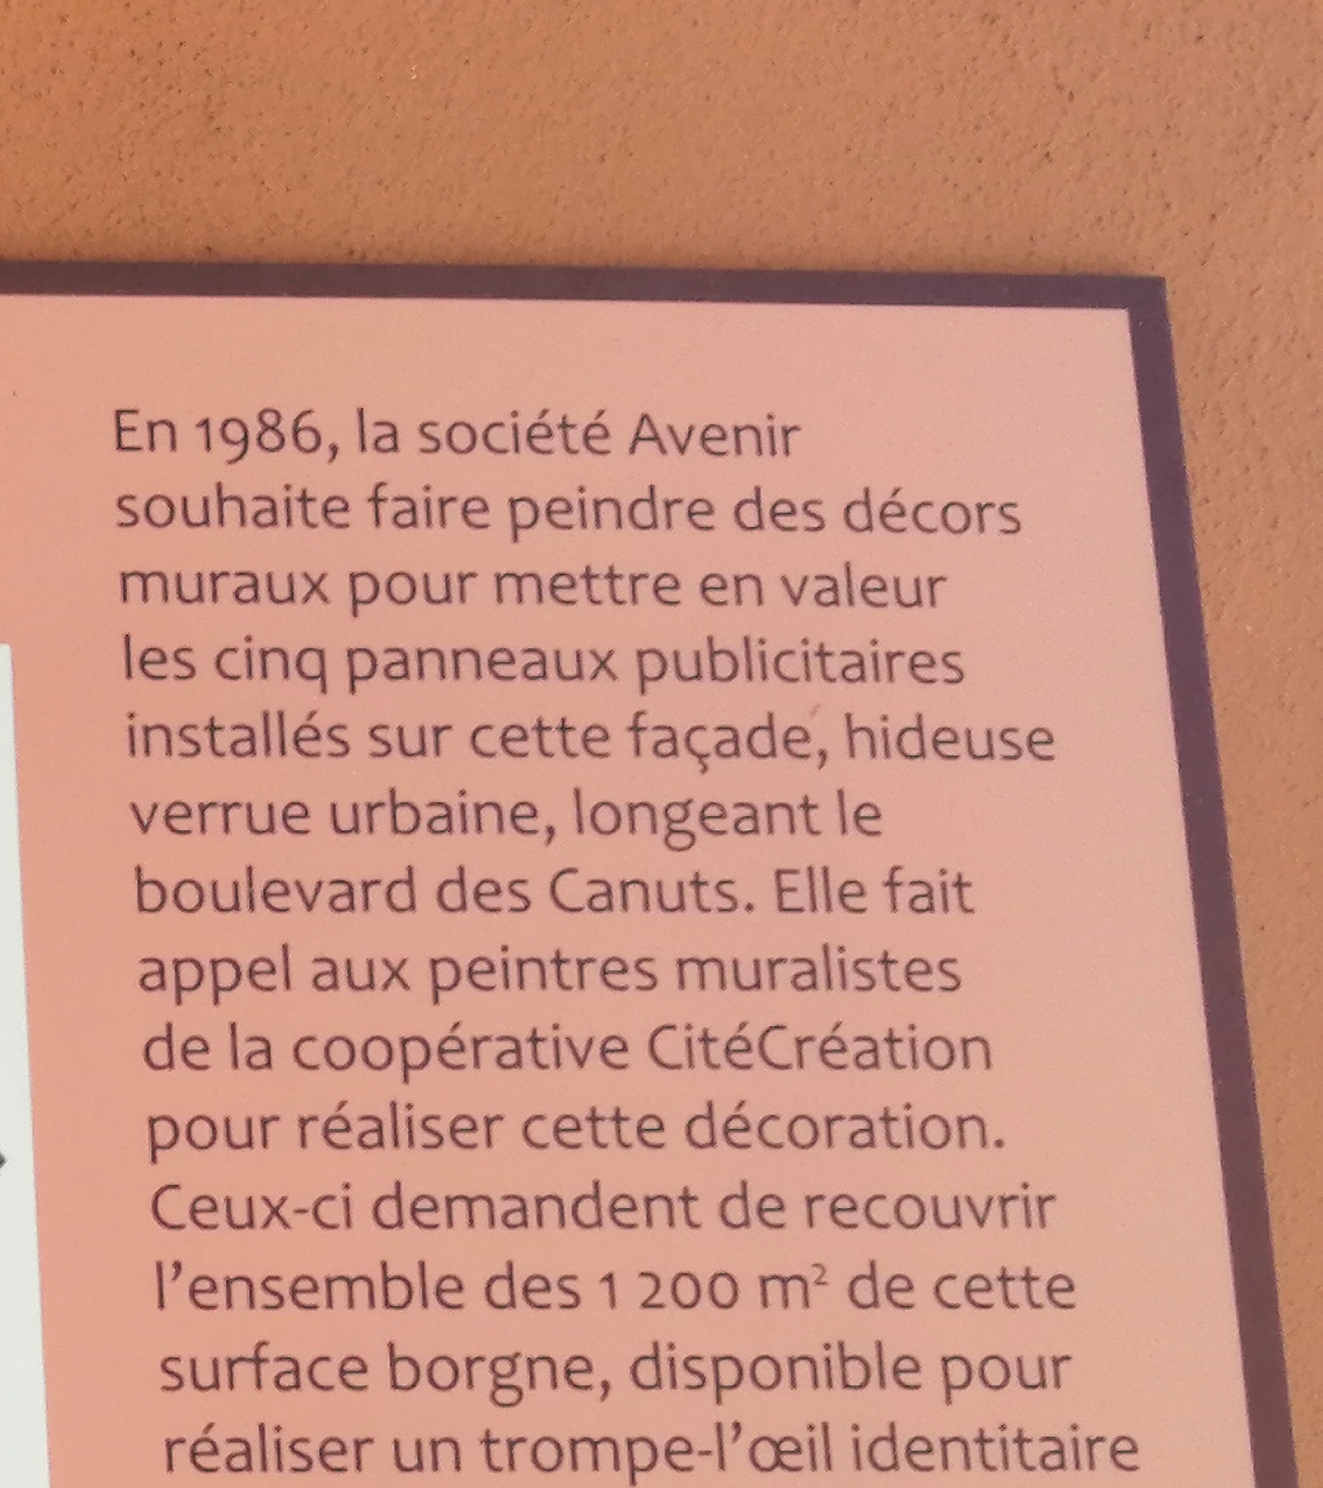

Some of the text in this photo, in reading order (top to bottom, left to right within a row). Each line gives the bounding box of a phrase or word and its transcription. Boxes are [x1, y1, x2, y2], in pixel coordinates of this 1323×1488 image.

[113, 406, 803, 466] En 1986, la société Avenir
[115, 480, 1022, 545] souhaite faire peindre des décors
[119, 560, 948, 619] muraux pour mettre en valeur
[122, 631, 966, 697] les cinq panneaux publicitaires
[126, 708, 1056, 776] installés sur cette façade, hideuse
[128, 786, 883, 853] verrue urbaine, longeant le
[134, 863, 976, 915] boulevard des Canuts. Elle fait
[138, 941, 963, 1008] appel aux peintres muralistes
[141, 1020, 993, 1086] de la coopérative CitéCréation
[146, 1099, 1006, 1166] pour réaliser cette décoration.
[150, 1178, 1058, 1232] Ceux-ci demandent de recouvrir
[483, 1259, 582, 1311] des
[598, 1270, 617, 1311] 1
[637, 1270, 742, 1311] 200
[846, 1258, 916, 1311] de
[932, 1265, 1077, 1311] cette
[159, 1339, 1073, 1409] surface borgne, disponible pour
[164, 1421, 376, 1474] réaliser
[393, 1436, 462, 1474] un
[850, 1420, 1141, 1473] identitaire
